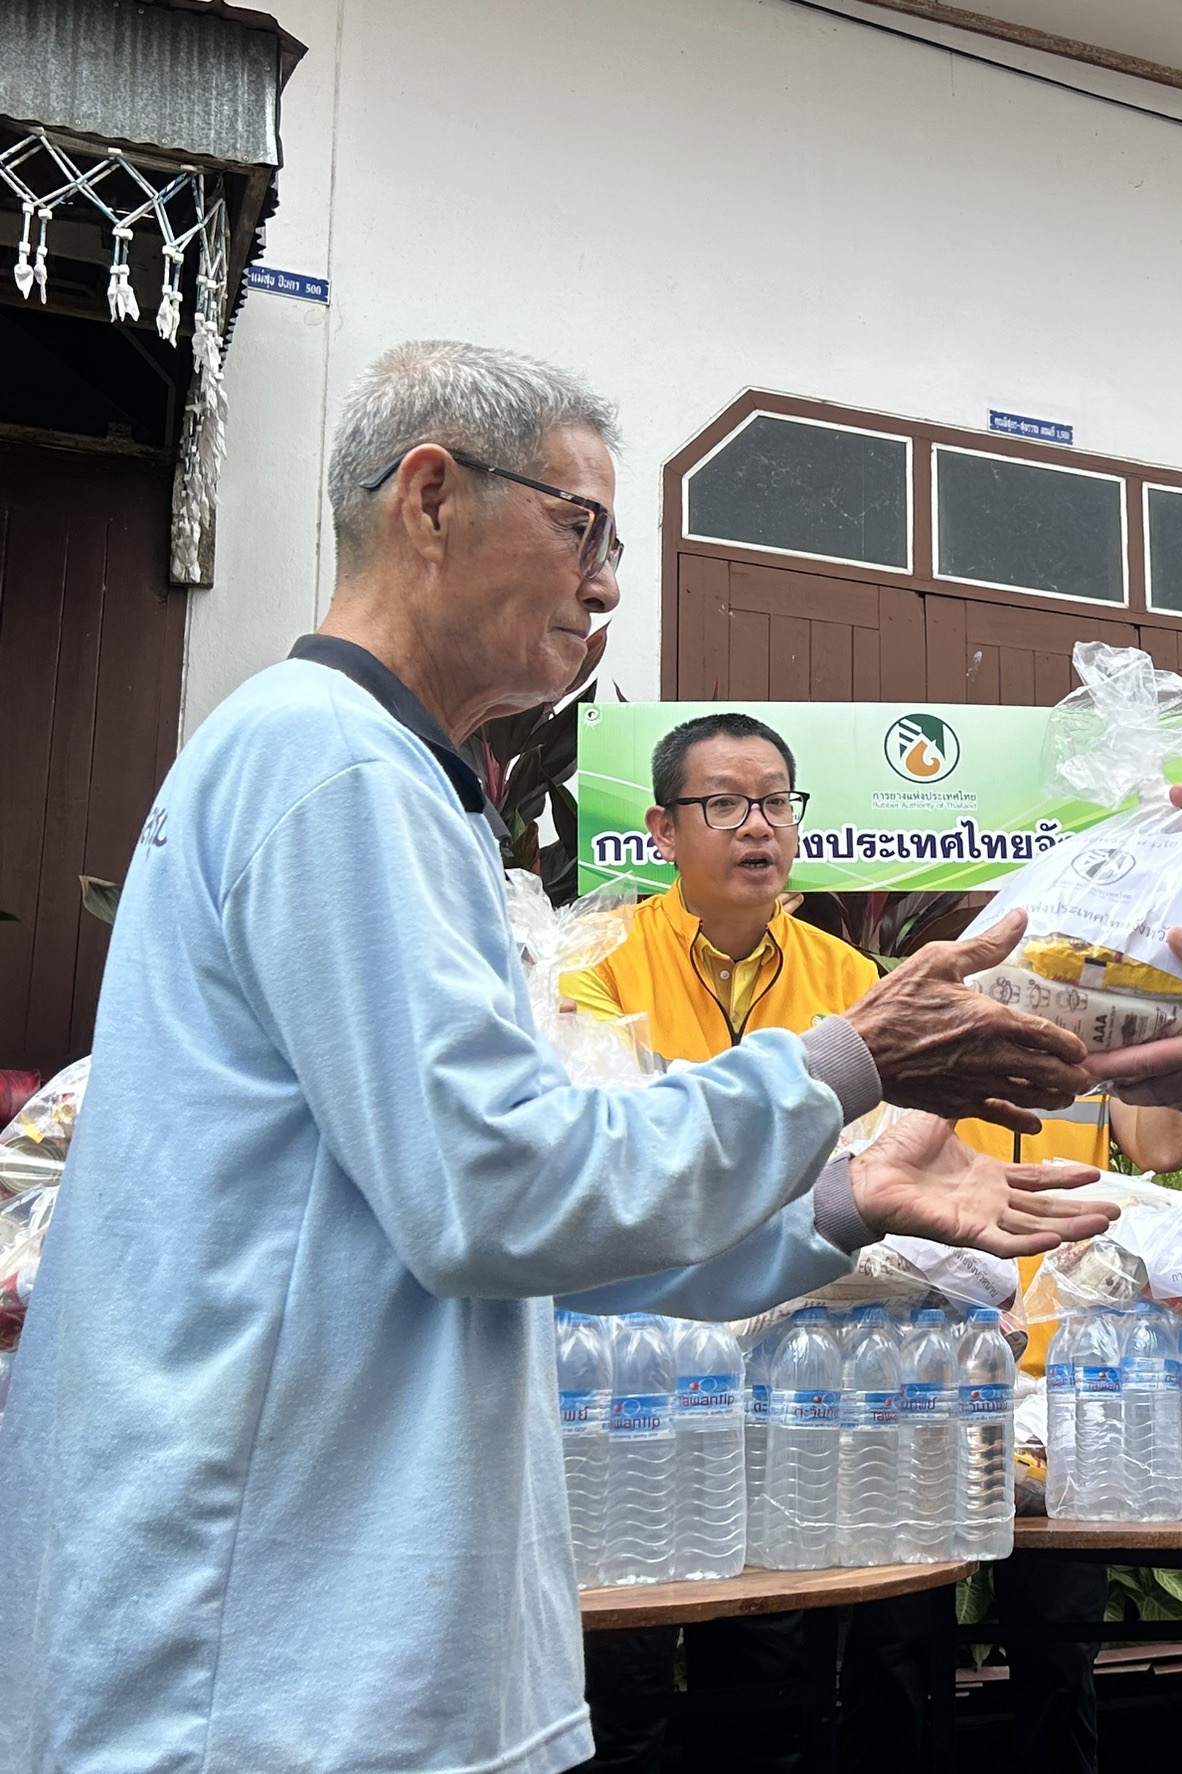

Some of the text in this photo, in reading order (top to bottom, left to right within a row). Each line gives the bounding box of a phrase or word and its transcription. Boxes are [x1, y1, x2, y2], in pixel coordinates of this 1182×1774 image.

[305, 283, 322, 295] 500
[872, 790, 977, 801] การยางแห่งประเทศไทย
[901, 802, 935, 811] Authority
[1093, 1014, 1107, 1043] AAA
